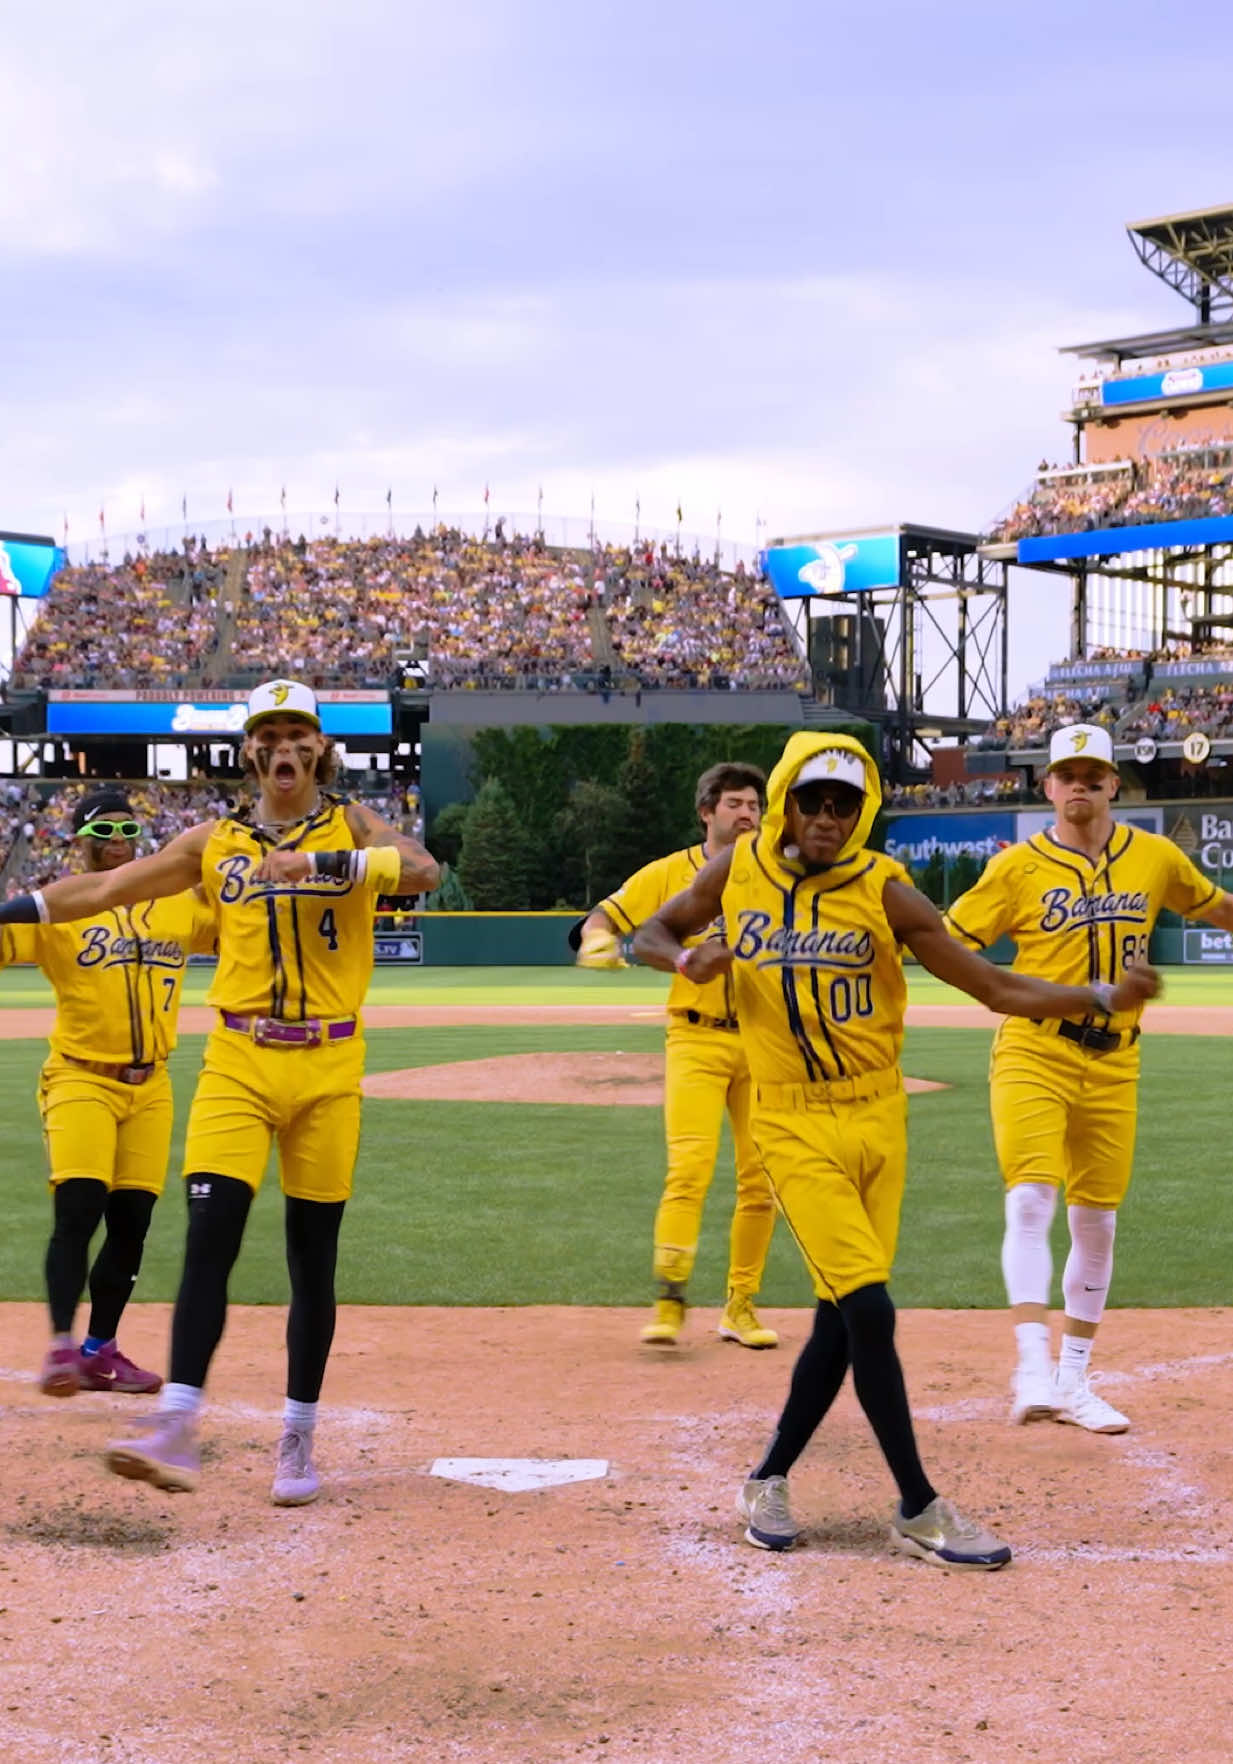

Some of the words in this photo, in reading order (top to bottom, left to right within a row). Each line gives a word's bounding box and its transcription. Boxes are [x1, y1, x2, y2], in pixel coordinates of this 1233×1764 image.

[1190, 741, 1204, 756] 17
[885, 836, 993, 861] Southwest
[318, 908, 337, 951] 4
[735, 910, 875, 968] Bananas
[163, 978, 175, 1011] 7
[830, 973, 873, 1023] 00
